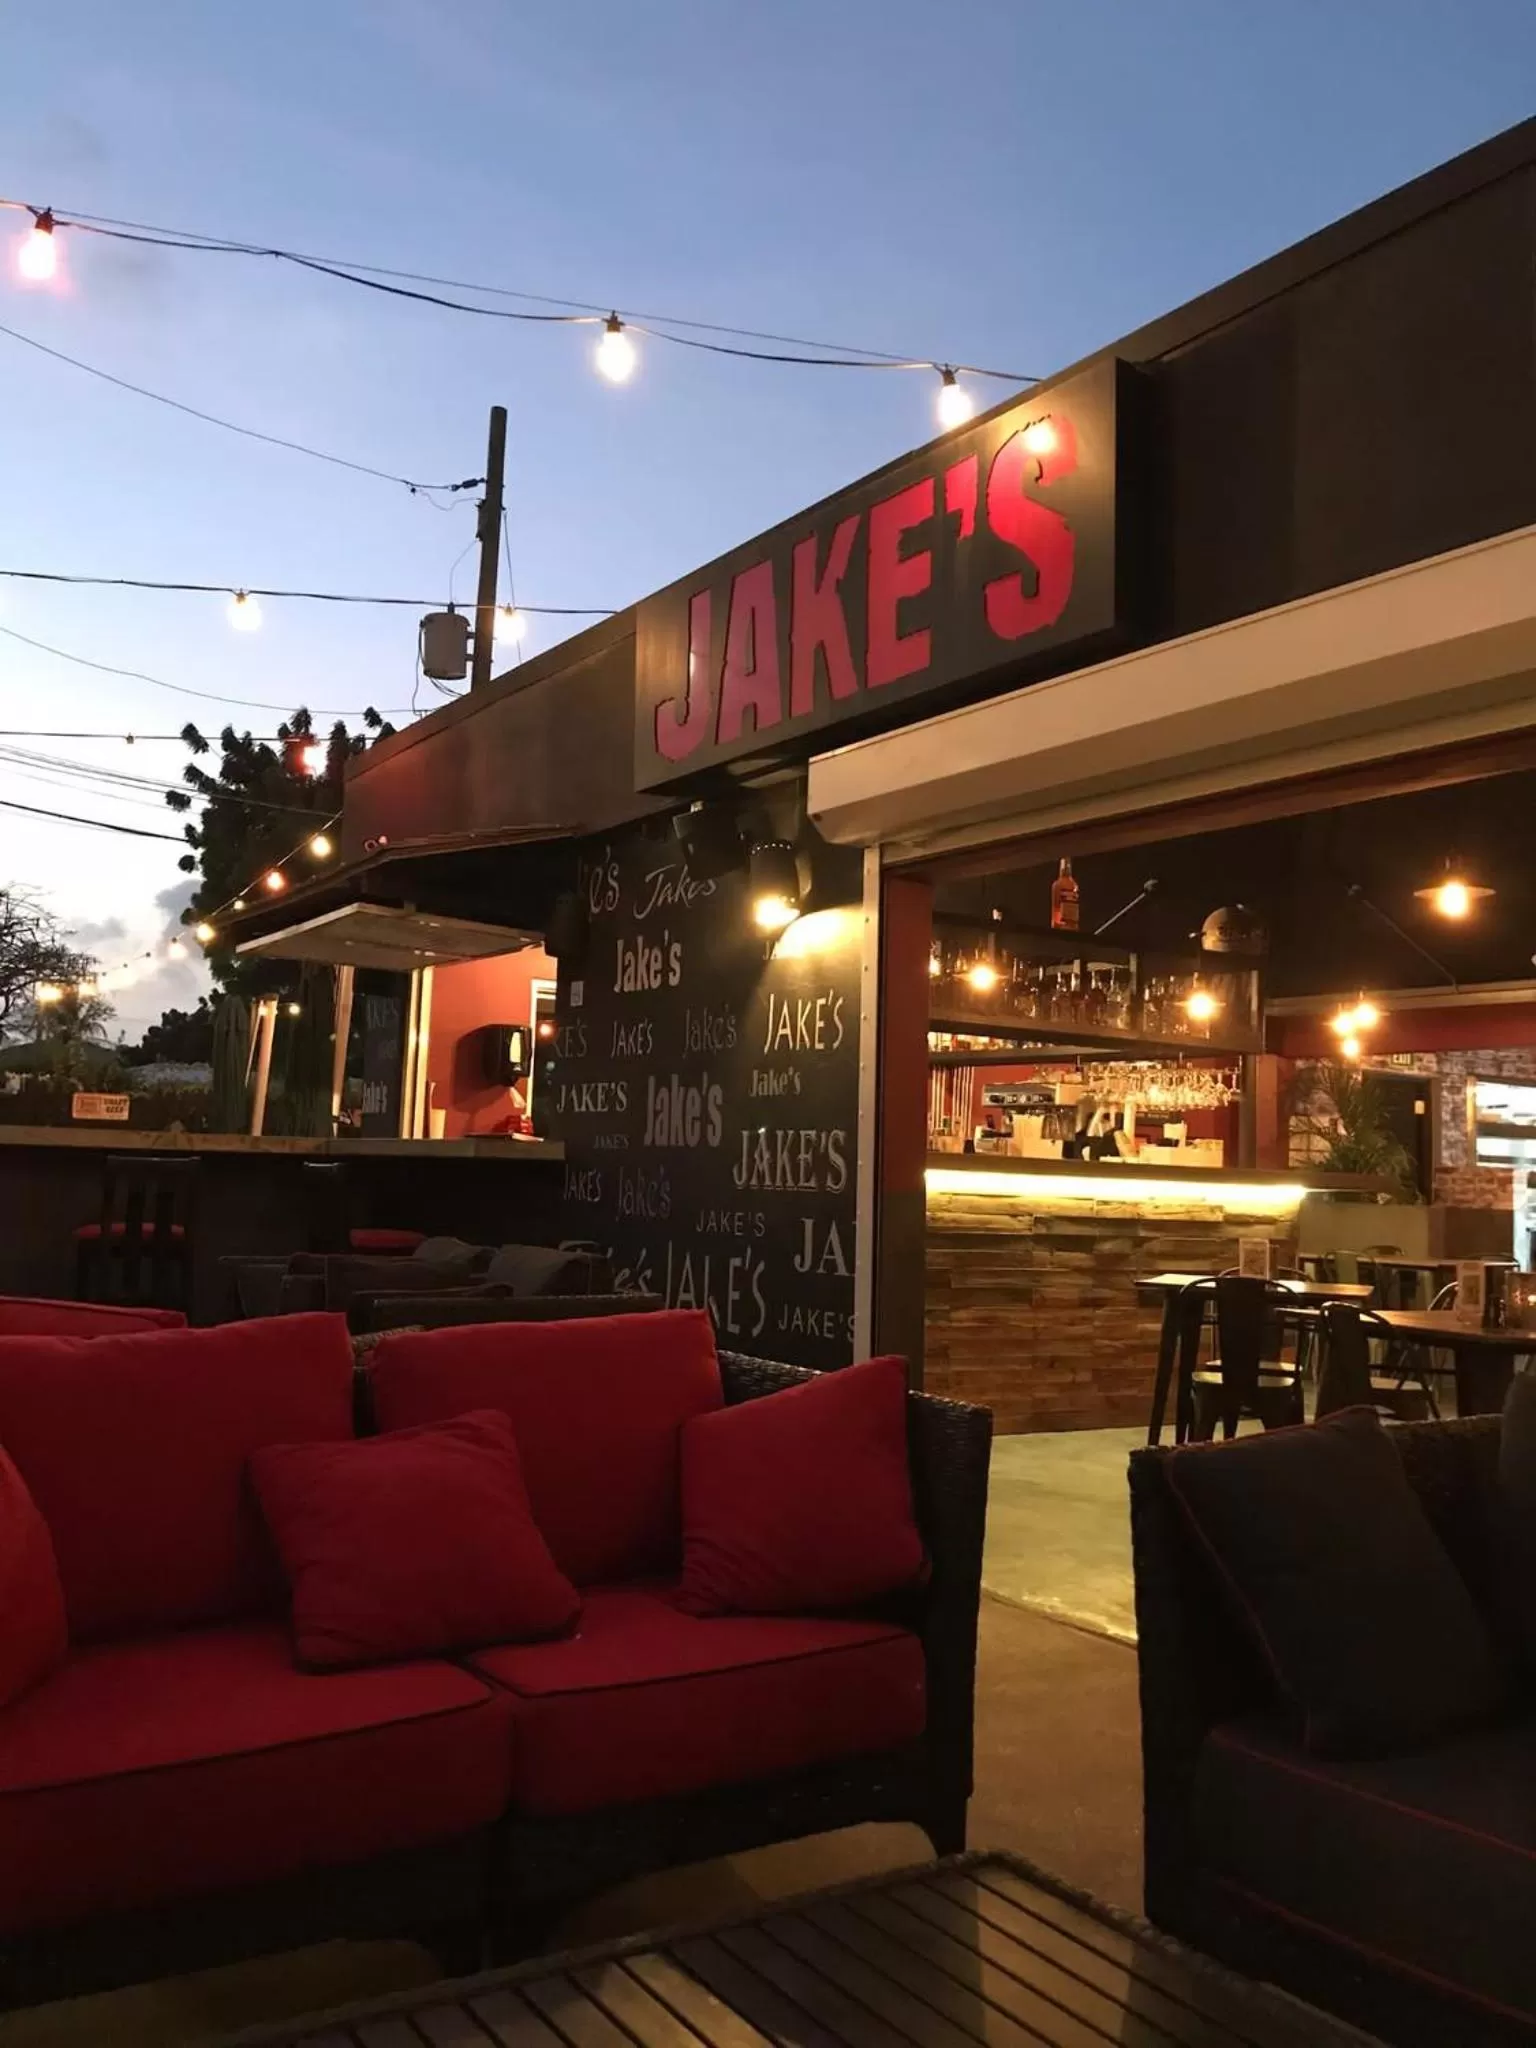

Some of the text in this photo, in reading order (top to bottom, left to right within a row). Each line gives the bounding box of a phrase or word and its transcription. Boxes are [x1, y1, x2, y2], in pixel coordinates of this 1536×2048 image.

[654, 413, 1077, 763] JAKE'S
[613, 928, 682, 993] Jake's
[610, 1017, 653, 1059] JAKE'S
[682, 1004, 738, 1057] Jake's
[764, 988, 844, 1056] JAKE'S
[556, 1081, 629, 1113] JAKE'S
[644, 1071, 724, 1147] Jake's
[749, 1066, 801, 1097] Jake's
[593, 1134, 629, 1149] JAKE'S
[733, 1127, 848, 1193] JAKE'S
[615, 1164, 672, 1222] Jake's
[696, 1210, 766, 1237] JAKE'S
[793, 1216, 855, 1277] JA
